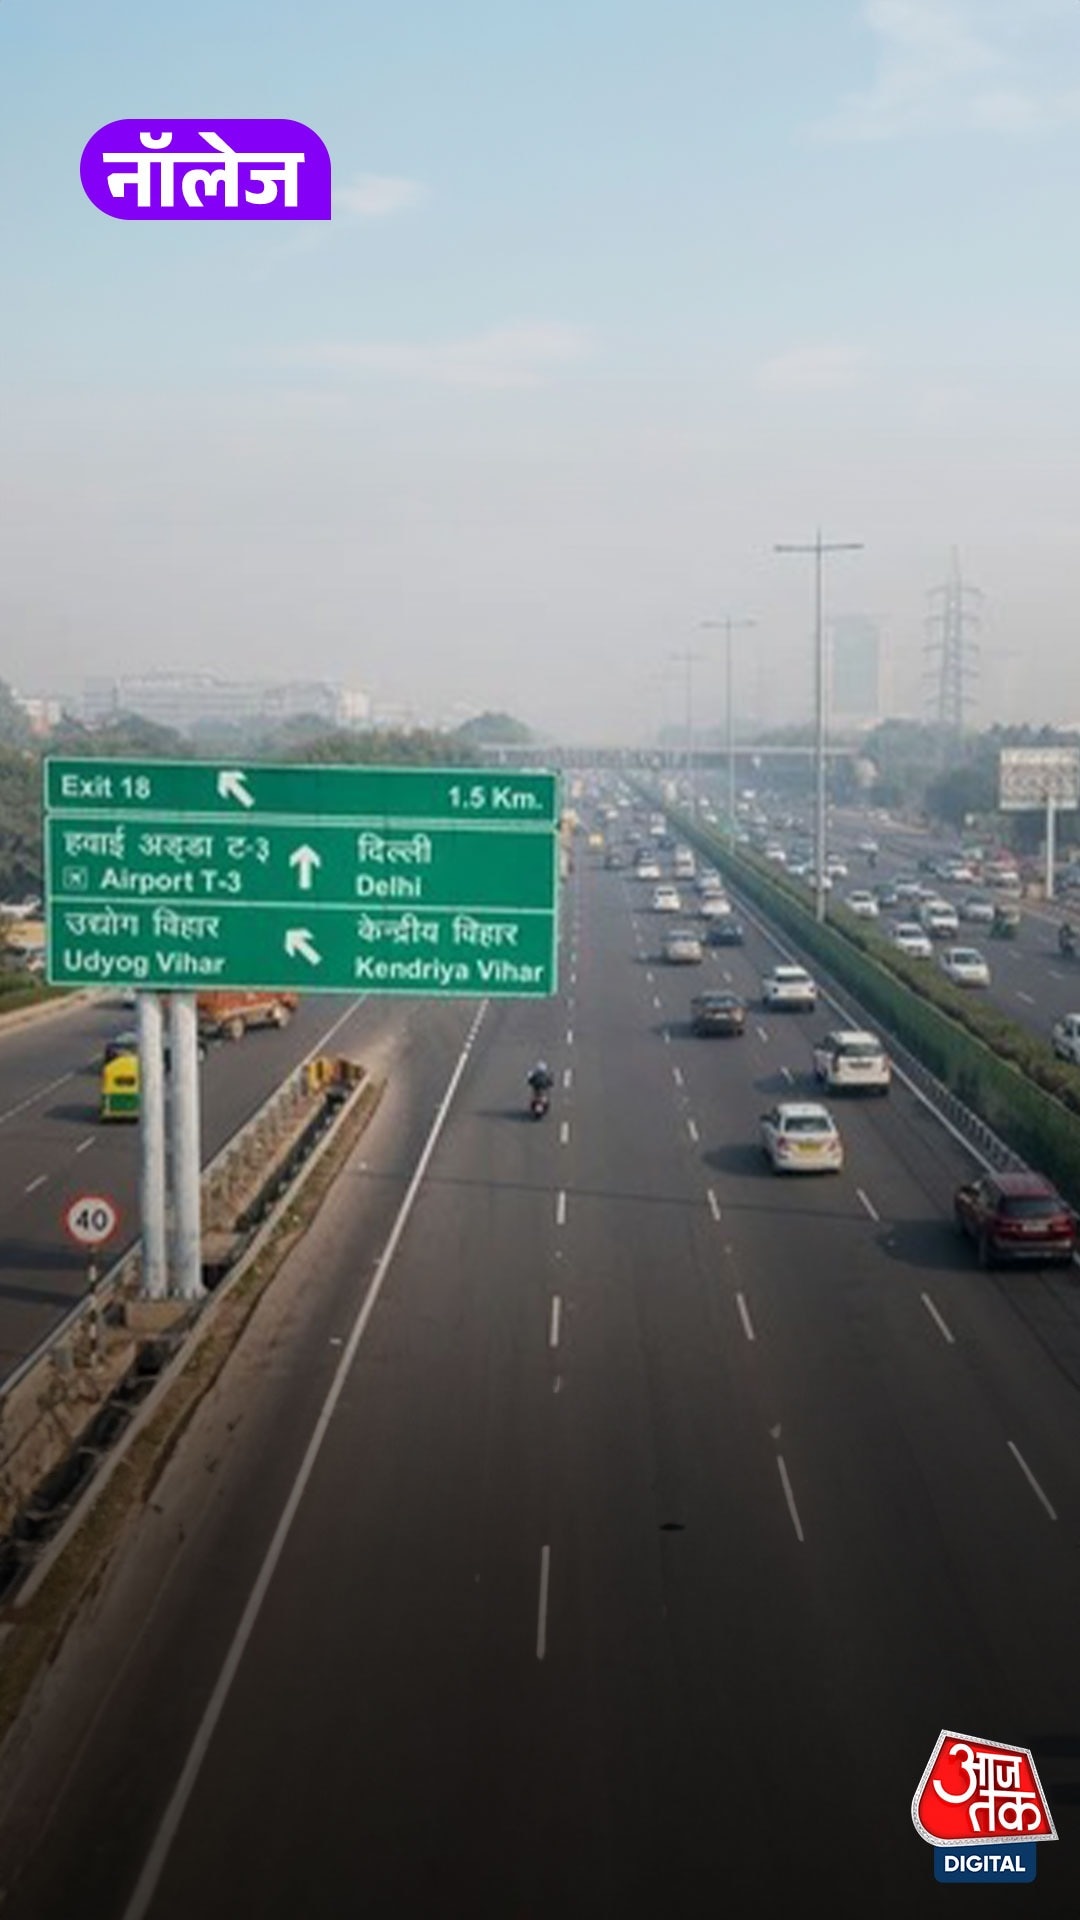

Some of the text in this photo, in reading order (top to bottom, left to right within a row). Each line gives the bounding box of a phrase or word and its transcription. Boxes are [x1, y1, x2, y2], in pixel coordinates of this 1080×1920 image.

[61, 774, 151, 799] Exit 18
[449, 786, 543, 810] 1.5 Km.
[63, 825, 126, 858] हवाई
[139, 832, 213, 864] अड्डा
[357, 832, 432, 864] दिल्ली
[101, 867, 243, 895] Airport T-3
[357, 874, 422, 898] Delhi
[64, 905, 220, 940] उद्योग विहार
[357, 912, 519, 948] केन्द्रीय विहार
[63, 949, 226, 976] Udyog Vihar
[355, 956, 545, 986] Kendriya Vihar
[75, 1208, 109, 1233] 40
